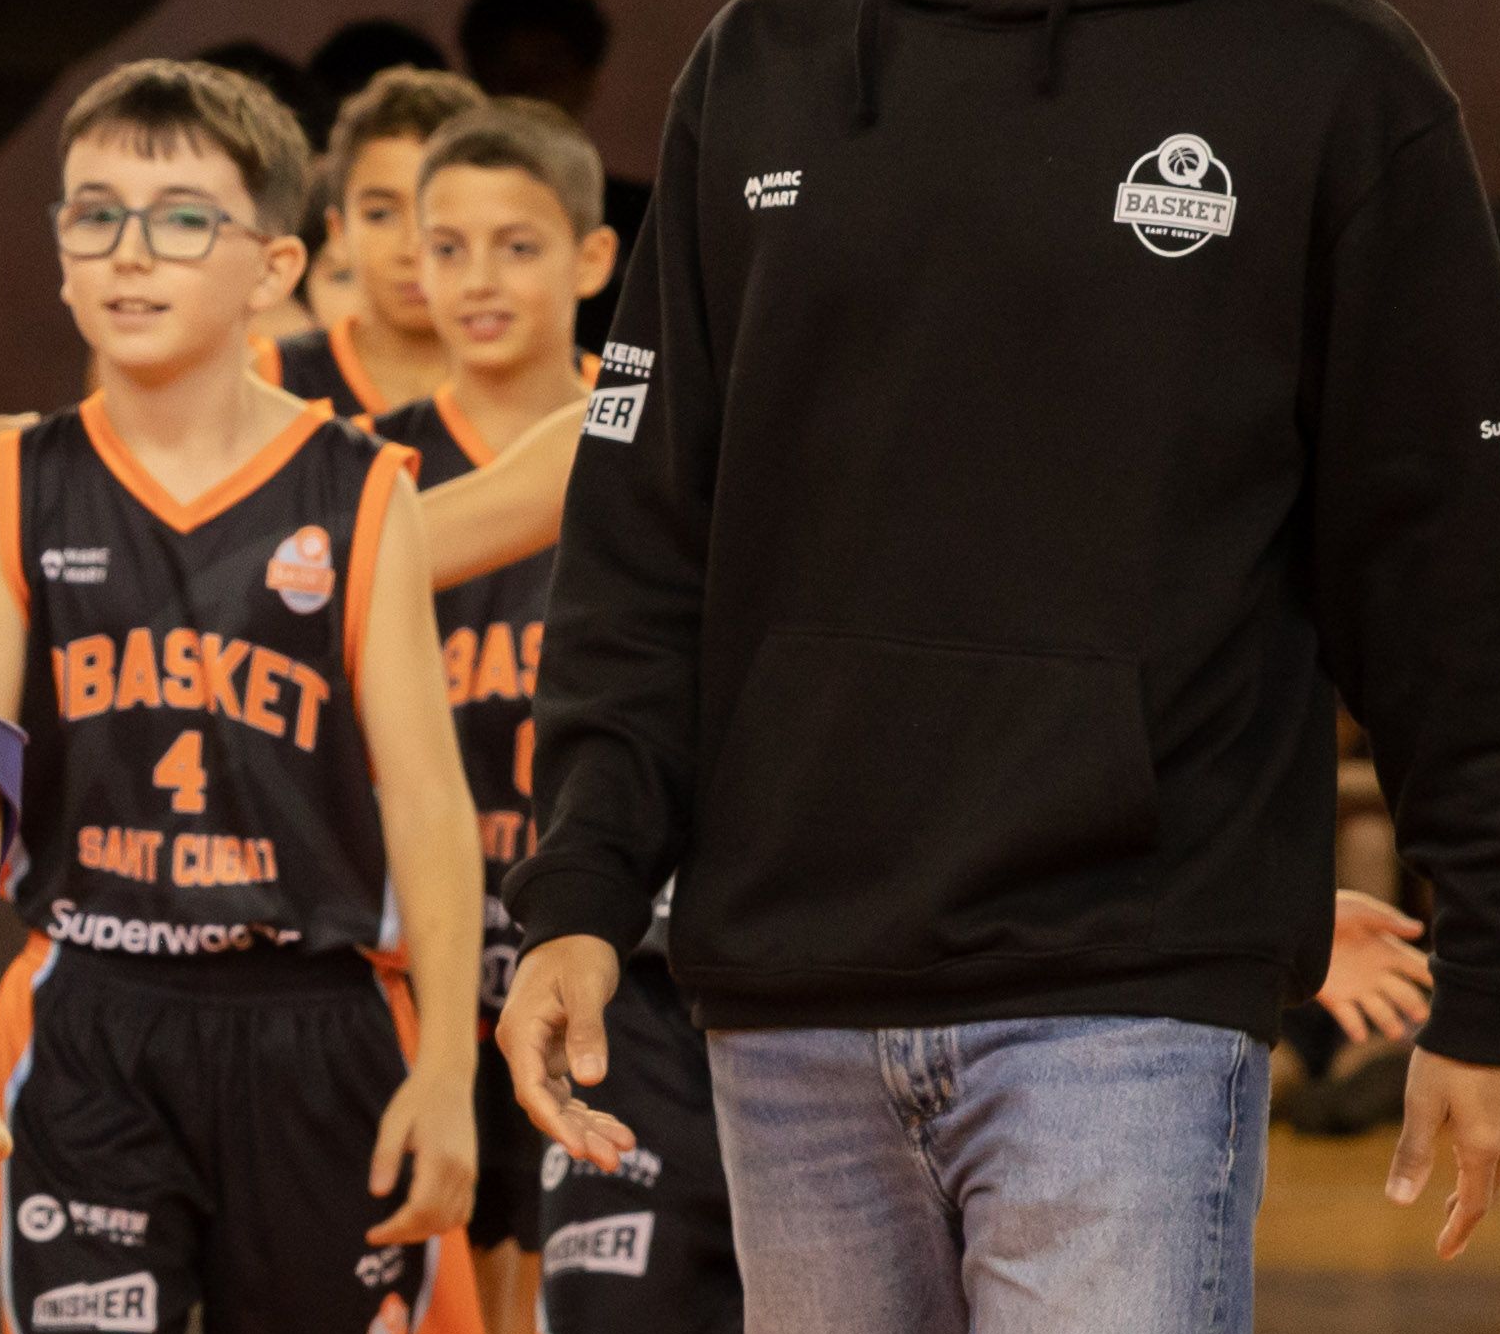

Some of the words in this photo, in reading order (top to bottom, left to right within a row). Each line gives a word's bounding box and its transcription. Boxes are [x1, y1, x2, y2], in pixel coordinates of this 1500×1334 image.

[762, 170, 802, 188] MARC
[760, 190, 799, 208] MART
[1125, 193, 1227, 224] BASKET
[602, 341, 656, 369] KERN
[52, 629, 329, 752] BASKET
[153, 731, 206, 813] 4
